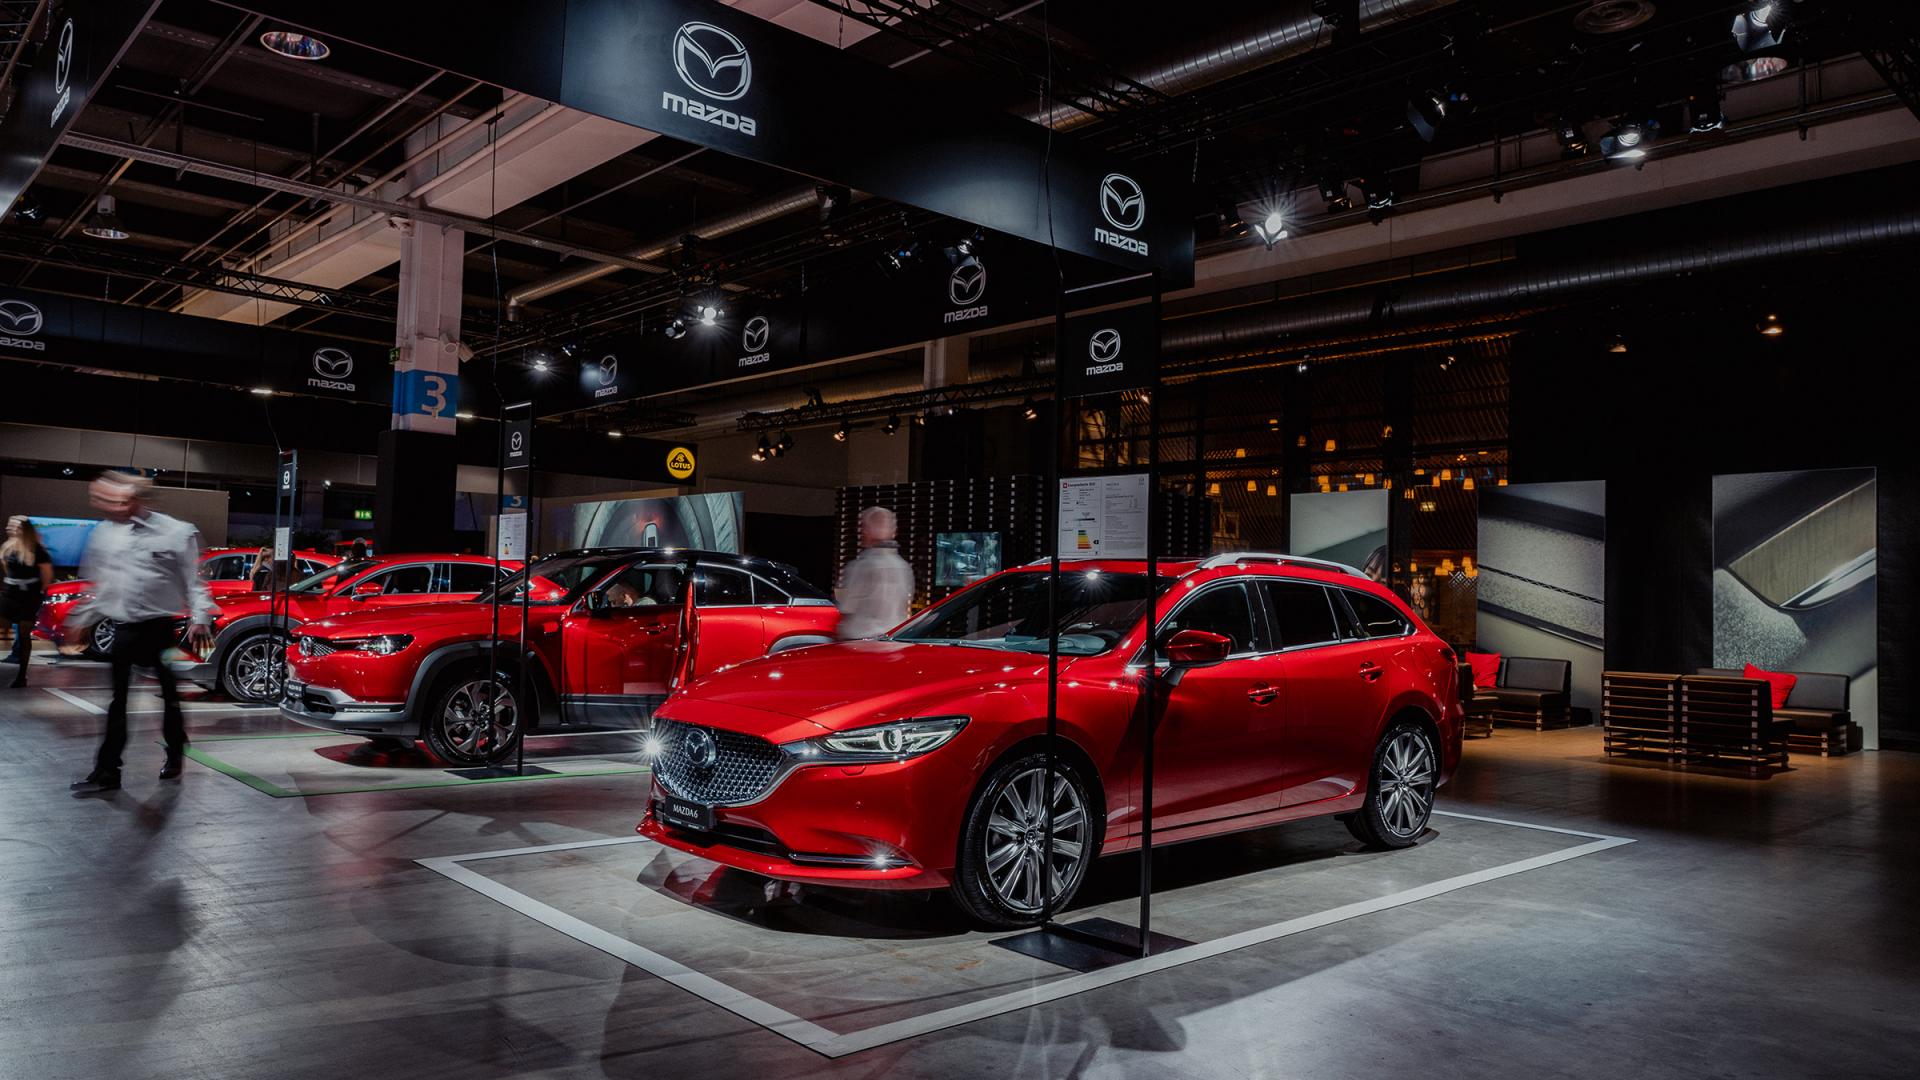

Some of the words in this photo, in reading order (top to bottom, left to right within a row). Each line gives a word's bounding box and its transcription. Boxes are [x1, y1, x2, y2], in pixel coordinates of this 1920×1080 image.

[420, 374, 448, 413] 3
[670, 461, 691, 469] LOTUS
[673, 803, 699, 819] MAZDA6
